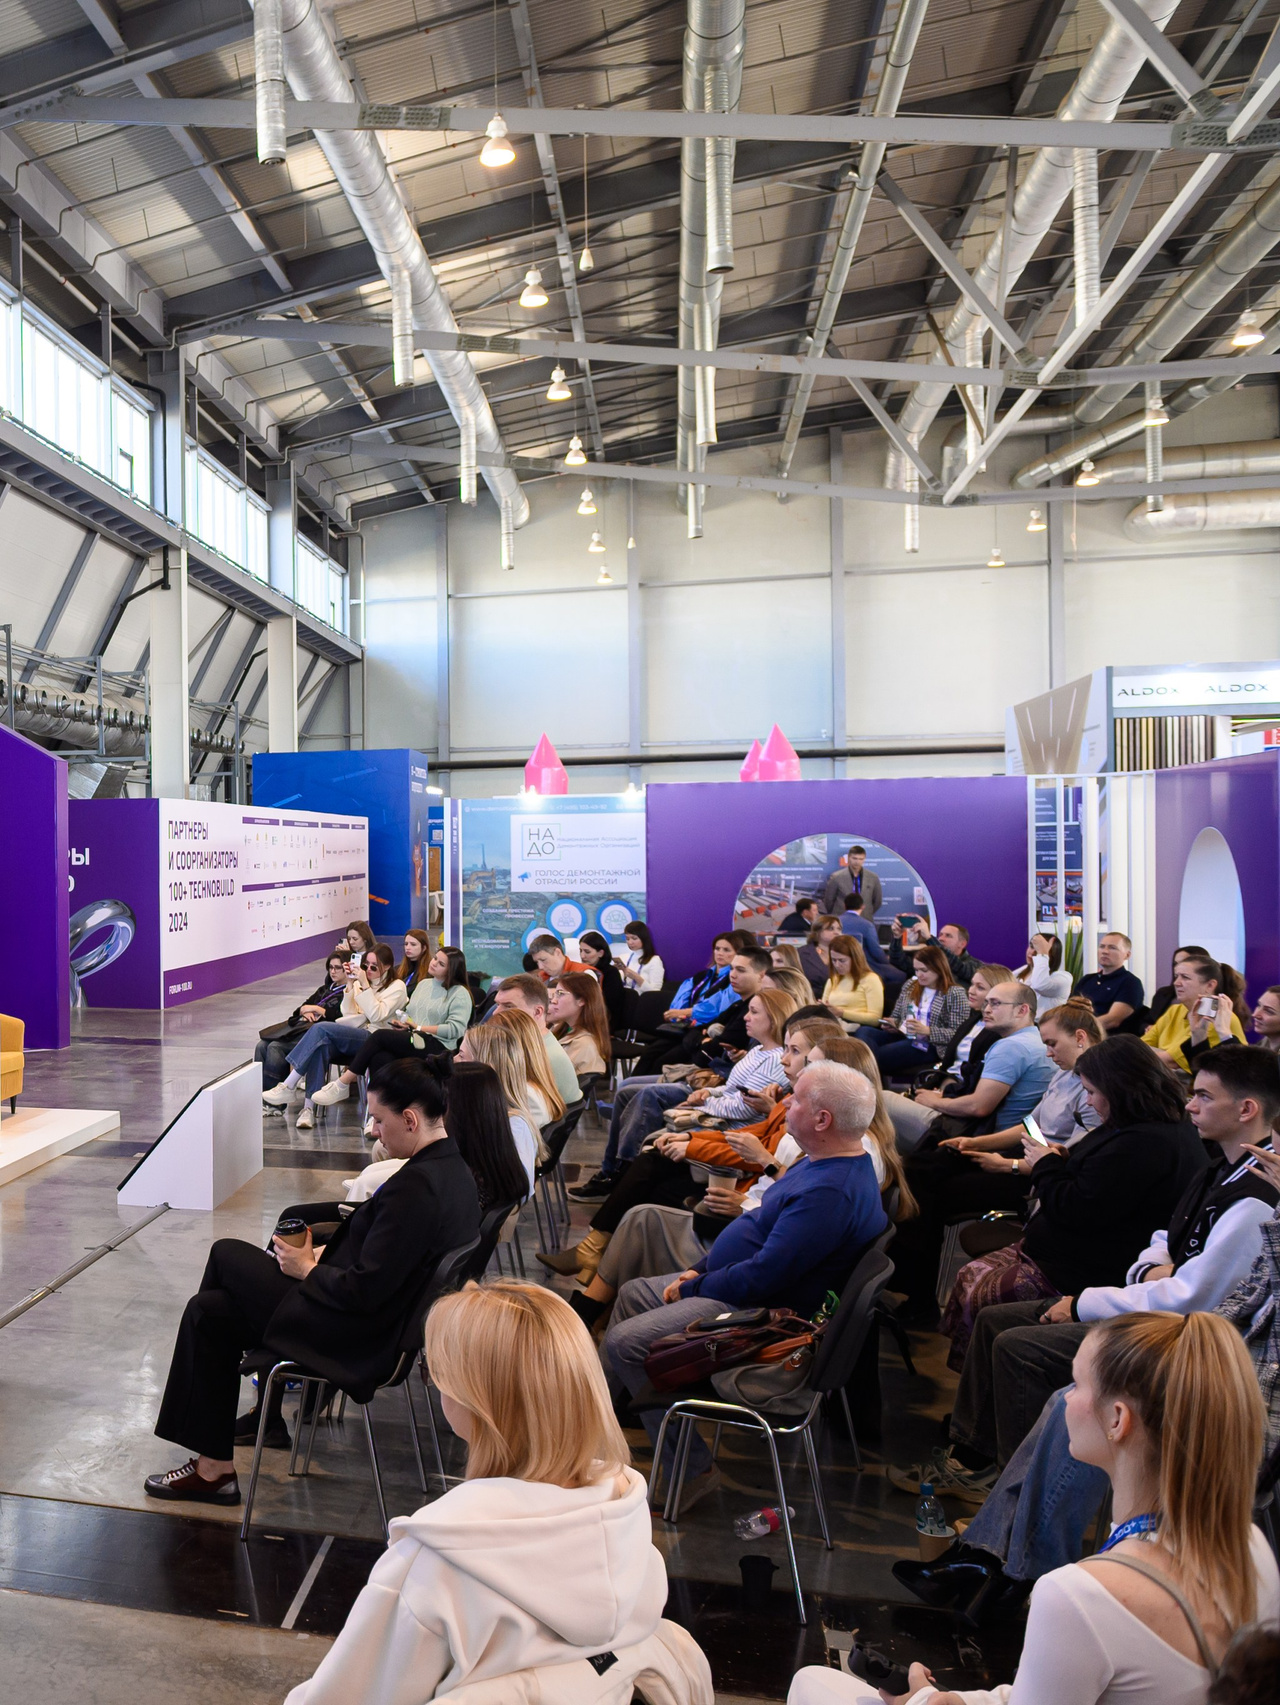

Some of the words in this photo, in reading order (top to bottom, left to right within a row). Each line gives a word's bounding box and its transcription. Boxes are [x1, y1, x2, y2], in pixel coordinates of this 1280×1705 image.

[1117, 687, 1181, 697] ALDOX
[1204, 683, 1269, 694] ALDOX
[168, 820, 209, 841] ПАРТНЕРЫ
[528, 827, 555, 841] НА
[527, 842, 555, 858] ДО
[169, 852, 175, 871] И
[176, 851, 239, 871] СООРГАНИЗАТОРЫ
[535, 869, 565, 877] ГОЛОС
[566, 868, 641, 878] ДЕМОНТАЖНОЙ
[535, 878, 578, 886] ОТРАСЛИ
[579, 878, 619, 886] РОССИИ
[169, 882, 188, 902] 100+
[189, 879, 235, 900] TECHNOBUILD
[169, 912, 189, 933] 2024
